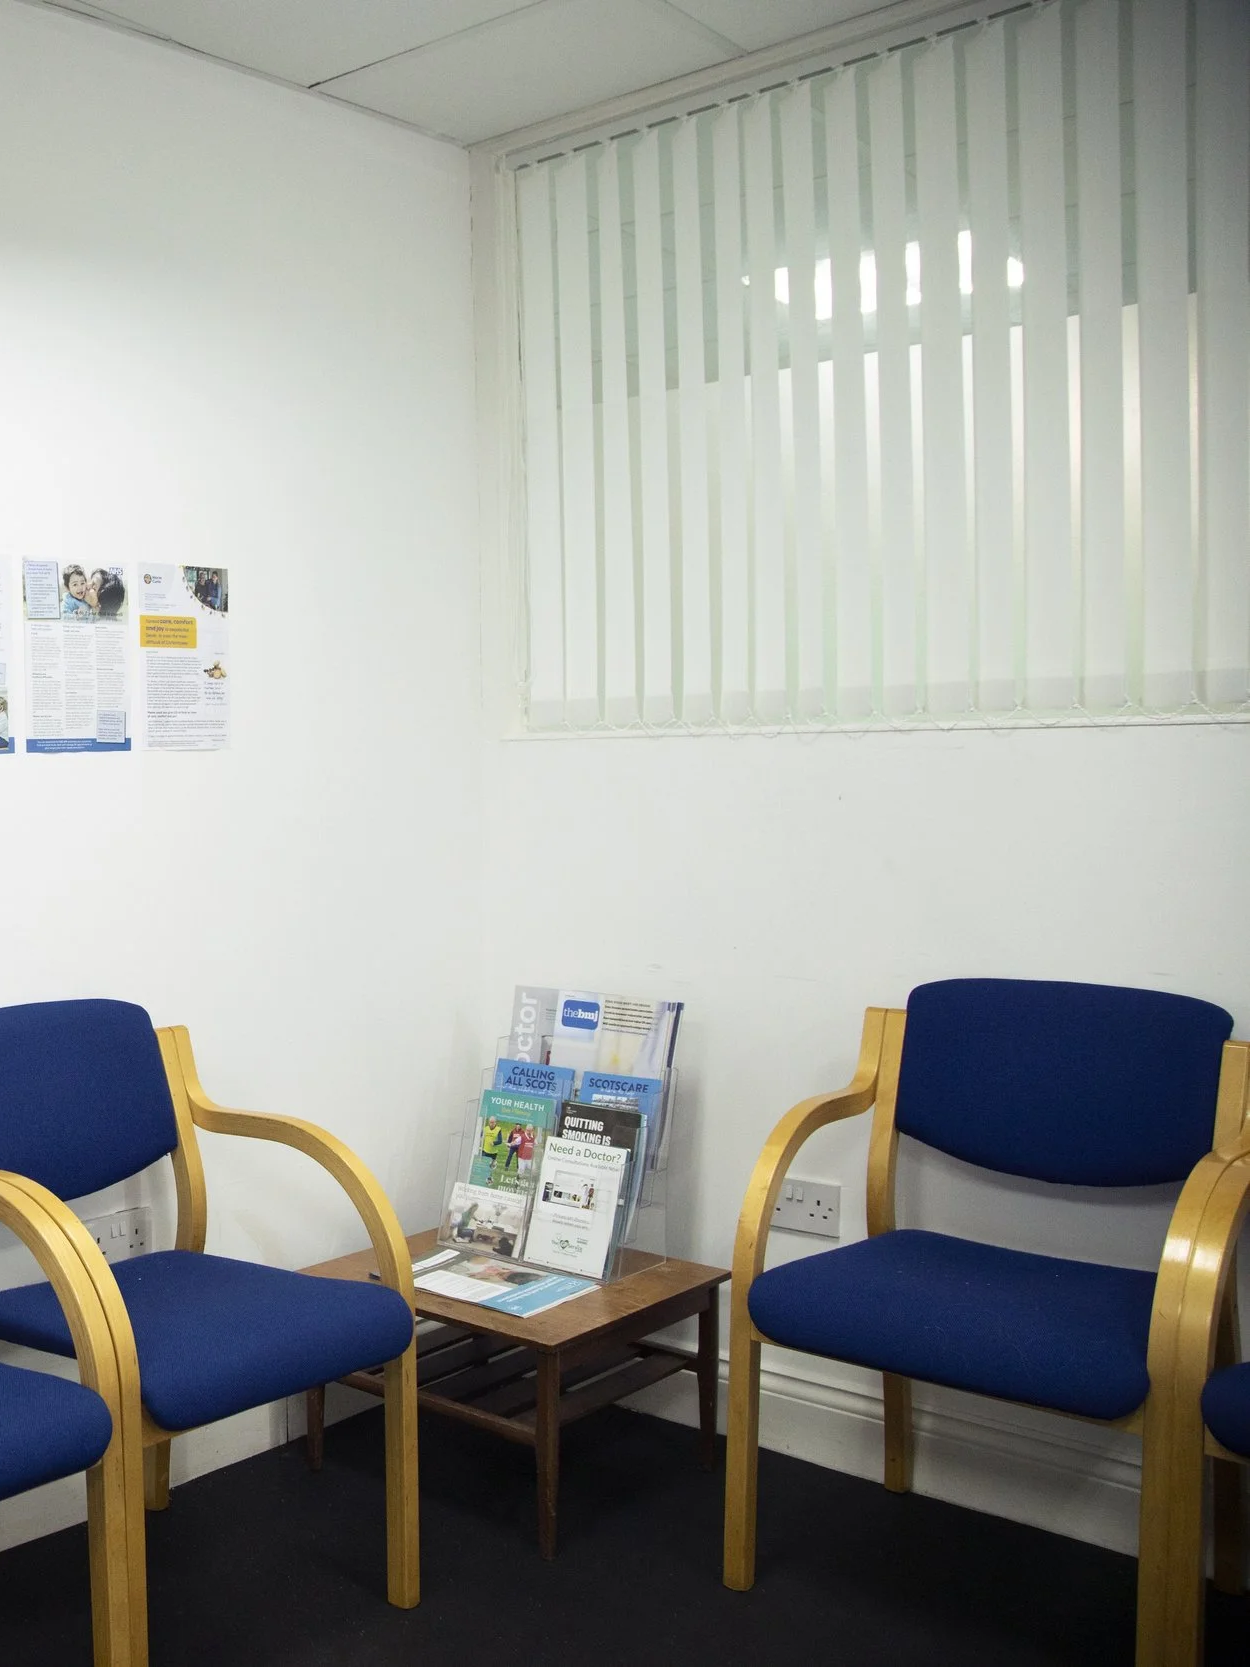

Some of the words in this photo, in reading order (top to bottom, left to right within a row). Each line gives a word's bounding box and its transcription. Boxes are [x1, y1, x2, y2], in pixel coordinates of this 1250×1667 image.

[564, 1008, 598, 1022] thebmj
[512, 1067, 555, 1080] CALLING
[505, 1076, 522, 1086] ALL
[525, 1079, 557, 1091] SCOTS
[589, 1078, 649, 1093] SCOTSCARE
[491, 1097, 512, 1106] YOUR
[514, 1101, 545, 1112] HEALTH
[564, 1116, 604, 1131] QUITTING
[562, 1129, 602, 1144] SMOKING
[602, 1135, 611, 1146] IS
[550, 1143, 574, 1155] Need
[584, 1149, 621, 1163] Doctor?
